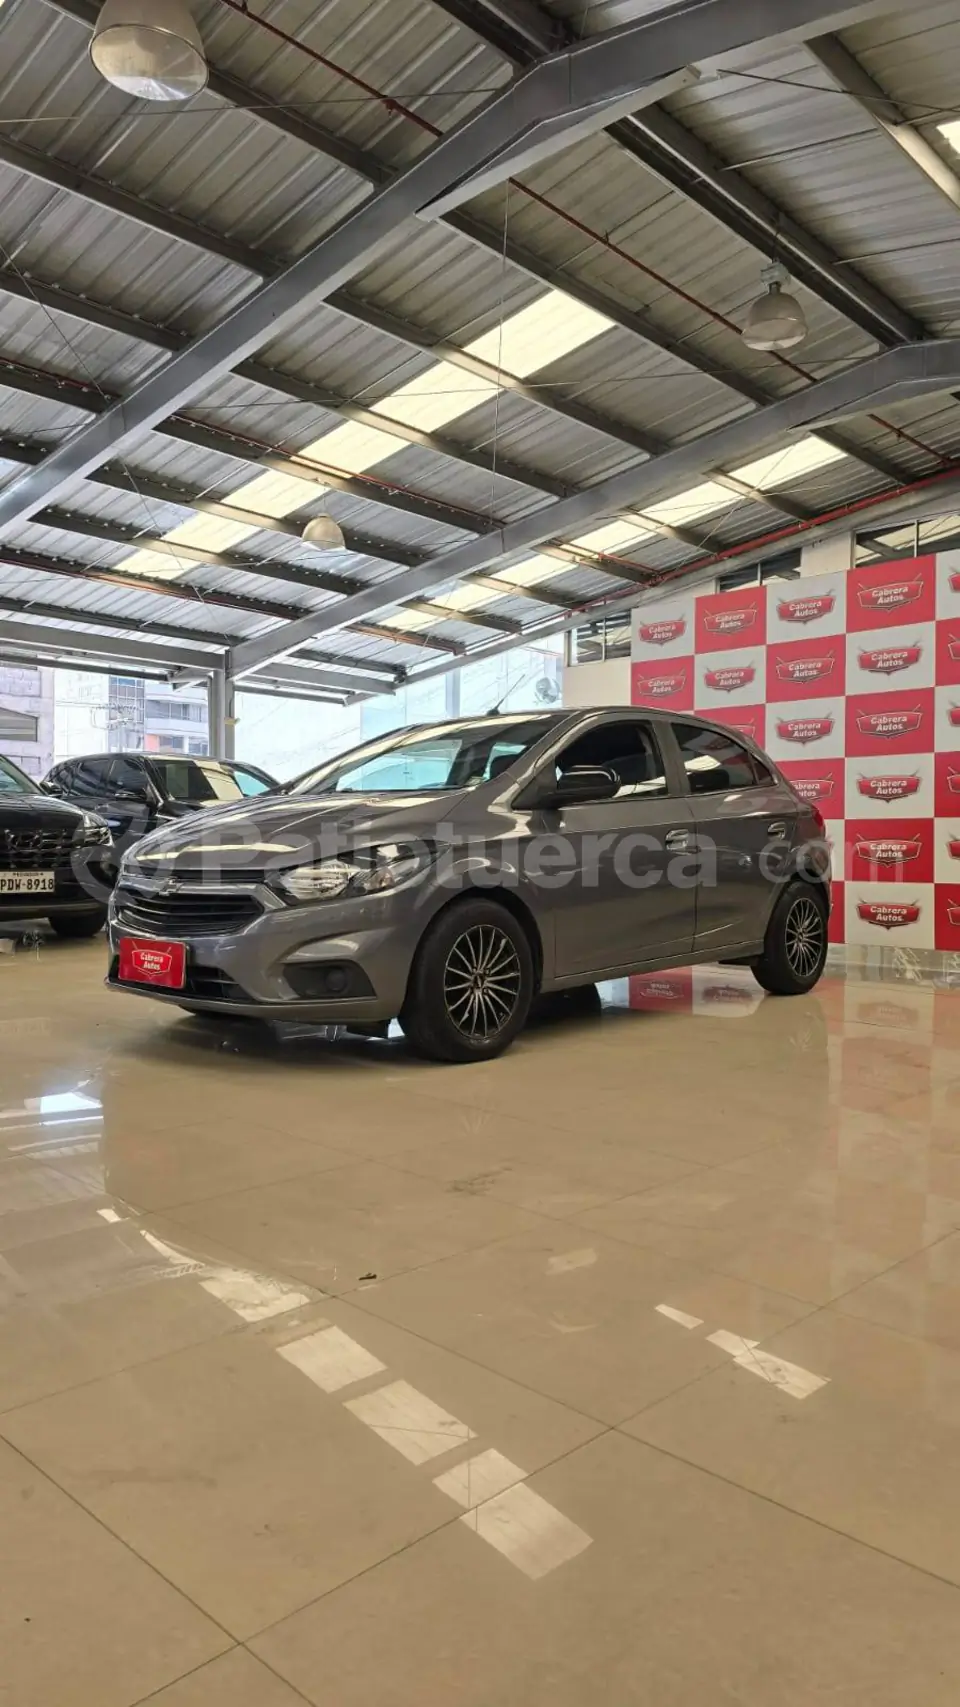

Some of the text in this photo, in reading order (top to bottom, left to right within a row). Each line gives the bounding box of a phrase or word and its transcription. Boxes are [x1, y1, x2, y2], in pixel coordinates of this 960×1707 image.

[872, 586, 909, 598] Cabrera
[877, 595, 904, 604] Autos
[789, 600, 822, 611] Cabrera
[794, 608, 818, 617] Autos
[715, 613, 745, 622] Cabrera
[720, 621, 741, 629] Autos
[871, 651, 909, 661] Cabrera
[788, 662, 822, 672] Cabrera
[876, 659, 903, 668] Autos
[715, 670, 745, 680] Cabrera
[793, 669, 818, 678] Autos
[719, 678, 741, 686] Autos
[870, 715, 907, 725] Cabrera
[787, 722, 821, 732] Cabrera
[876, 723, 903, 731] Autos
[793, 782, 820, 790] abrera
[870, 779, 907, 788] Cabrera
[876, 787, 902, 795] Autos
[870, 843, 907, 851] Cabrera
[875, 850, 903, 858] Autos
[0, 878, 54, 891] PDW-8918
[870, 906, 907, 915] Cabrera
[876, 913, 903, 922] Autos
[140, 952, 164, 963] Cabrera
[143, 961, 161, 971] Autos
